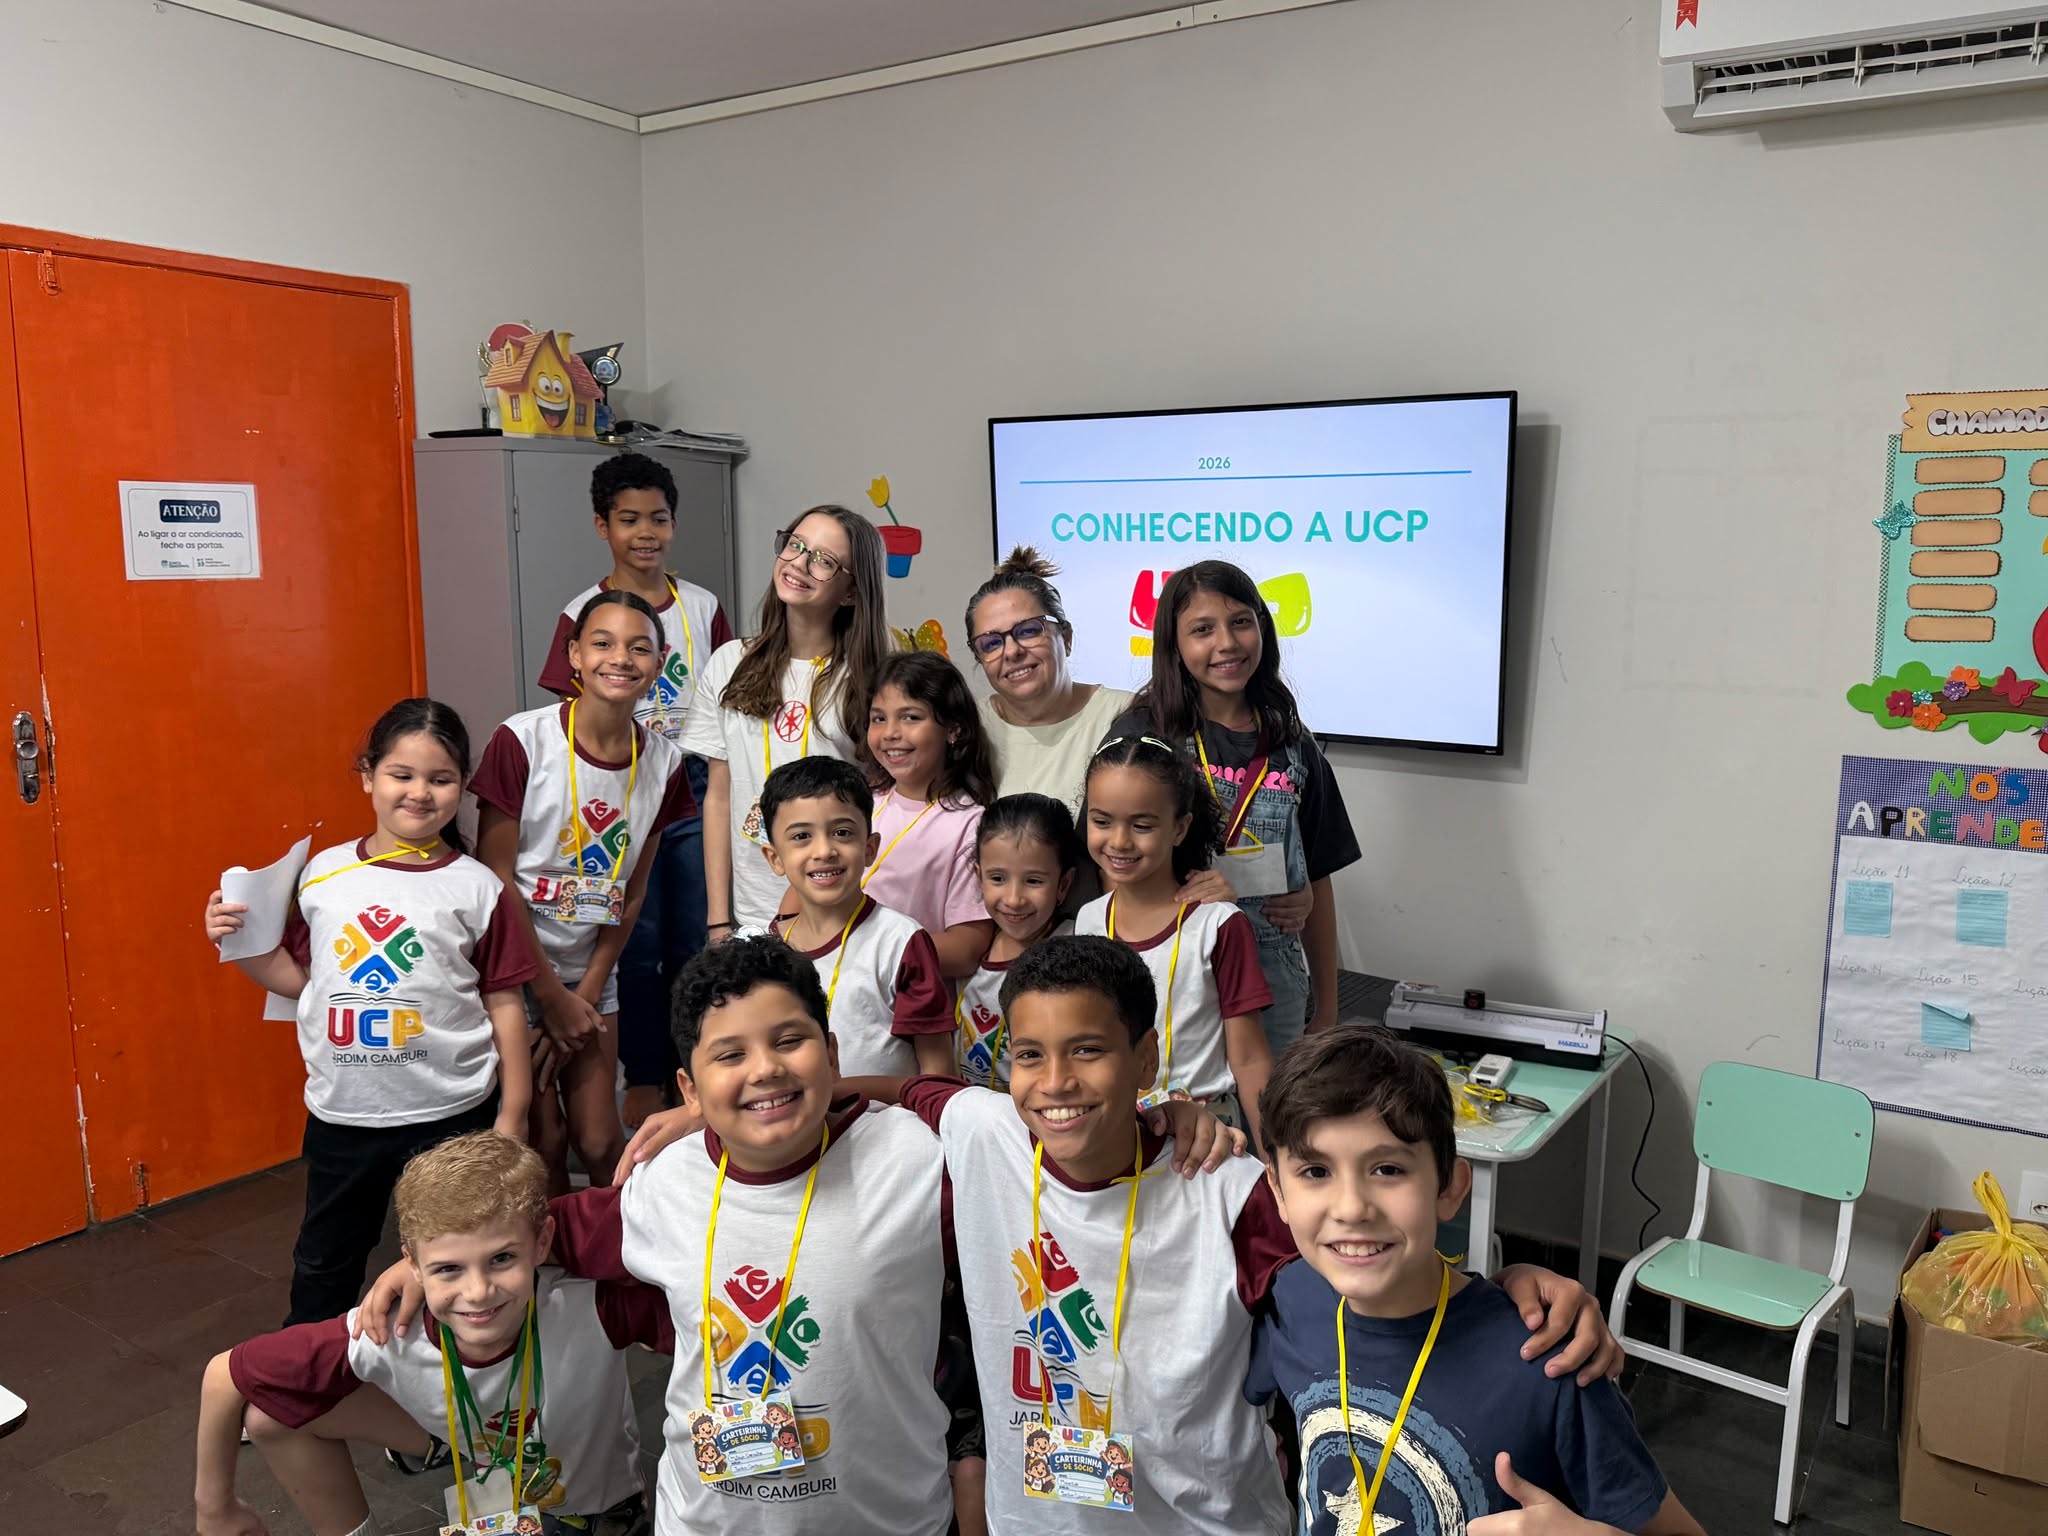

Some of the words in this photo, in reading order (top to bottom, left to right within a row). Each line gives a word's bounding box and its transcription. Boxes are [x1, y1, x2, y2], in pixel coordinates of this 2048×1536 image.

[1198, 456, 1231, 470] 2026
[162, 503, 218, 520] ATENÇÃO
[1051, 511, 1293, 542] CONHECENDO
[1304, 511, 1333, 542] A
[1345, 509, 1429, 542] UCP
[138, 530, 149, 538] Ao
[150, 530, 169, 540] ligar
[160, 541, 184, 550] feche
[185, 542, 196, 550] as
[197, 542, 225, 551] portas.
[1928, 766, 2031, 806] NÓS
[1847, 801, 2046, 849] APRENDE
[1851, 857, 1887, 880] Lição
[1952, 866, 1990, 887] Lição
[1999, 872, 2017, 888] 12
[1916, 967, 1952, 985] Lição
[1962, 974, 1979, 986] 15
[328, 1007, 425, 1047] UCP
[370, 1049, 428, 1064] CAMBURI
[1944, 1051, 1958, 1063] 18
[722, 1401, 753, 1419] UCP
[721, 1426, 767, 1442] CARTEIRINHA
[730, 1438, 739, 1446] DE
[1062, 1428, 1094, 1448] UCP
[1054, 1455, 1102, 1469] CARTEIRINHA
[757, 1477, 837, 1499] CAMBURI
[476, 1515, 505, 1530] UCP
